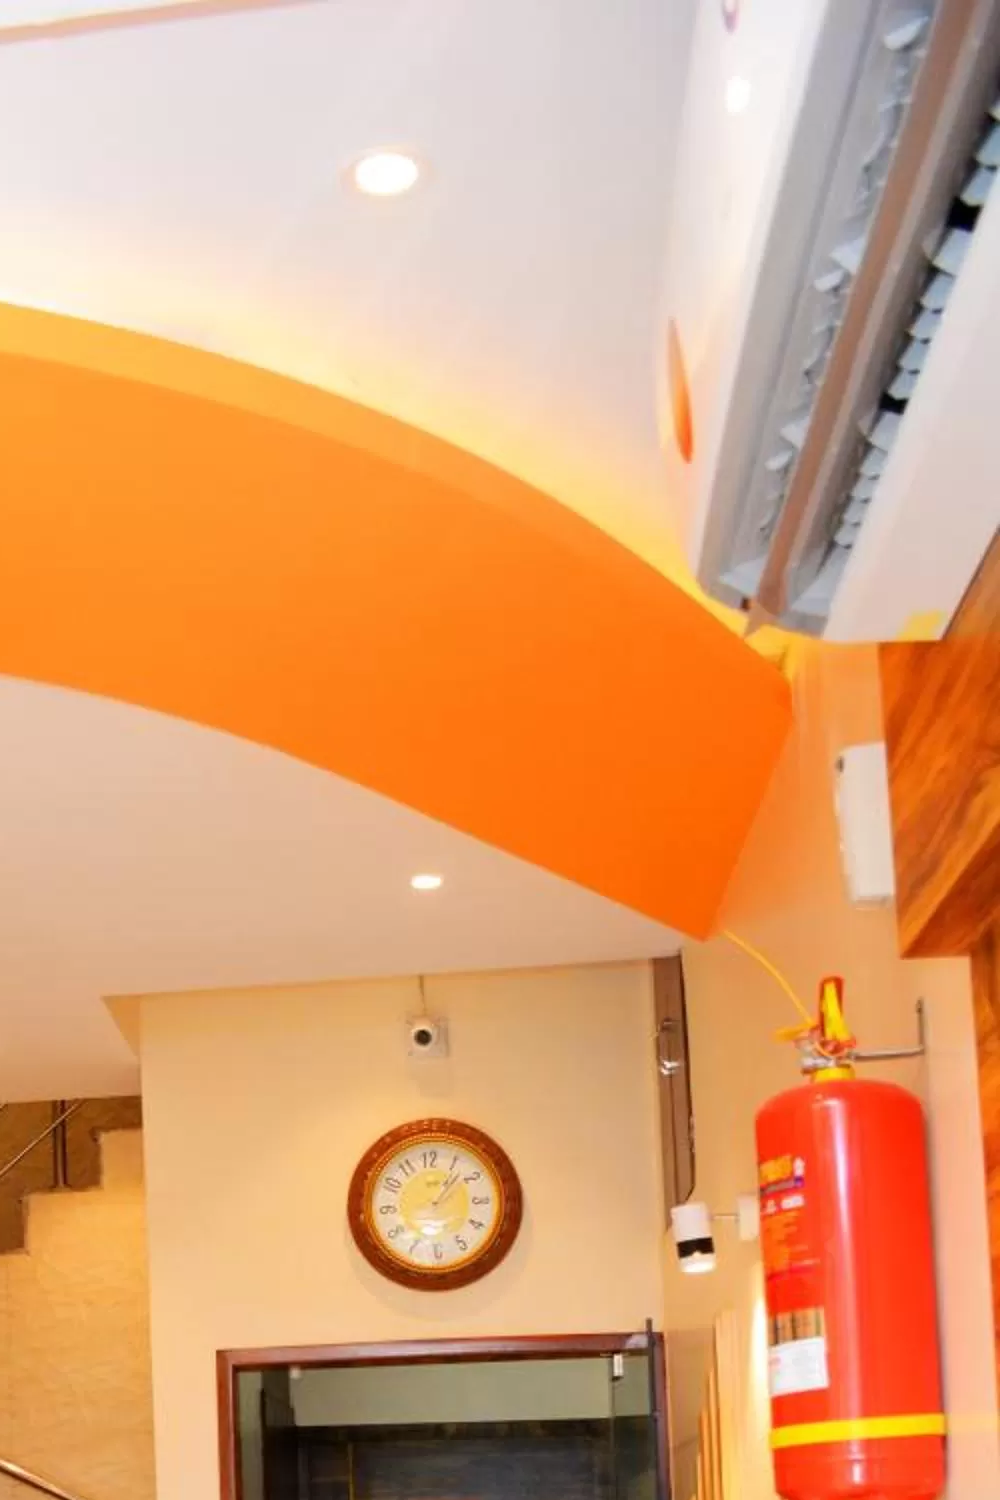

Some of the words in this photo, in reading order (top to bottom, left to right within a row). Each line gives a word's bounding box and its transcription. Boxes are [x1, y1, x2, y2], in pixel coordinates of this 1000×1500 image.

[421, 1150, 438, 1168] 12
[398, 1159, 417, 1177] 11
[463, 1171, 481, 1184] 2
[383, 1177, 402, 1194] 10
[472, 1196, 489, 1205] 3
[379, 1205, 397, 1215] 9
[469, 1218, 486, 1230] 4
[455, 1235, 468, 1251] 5
